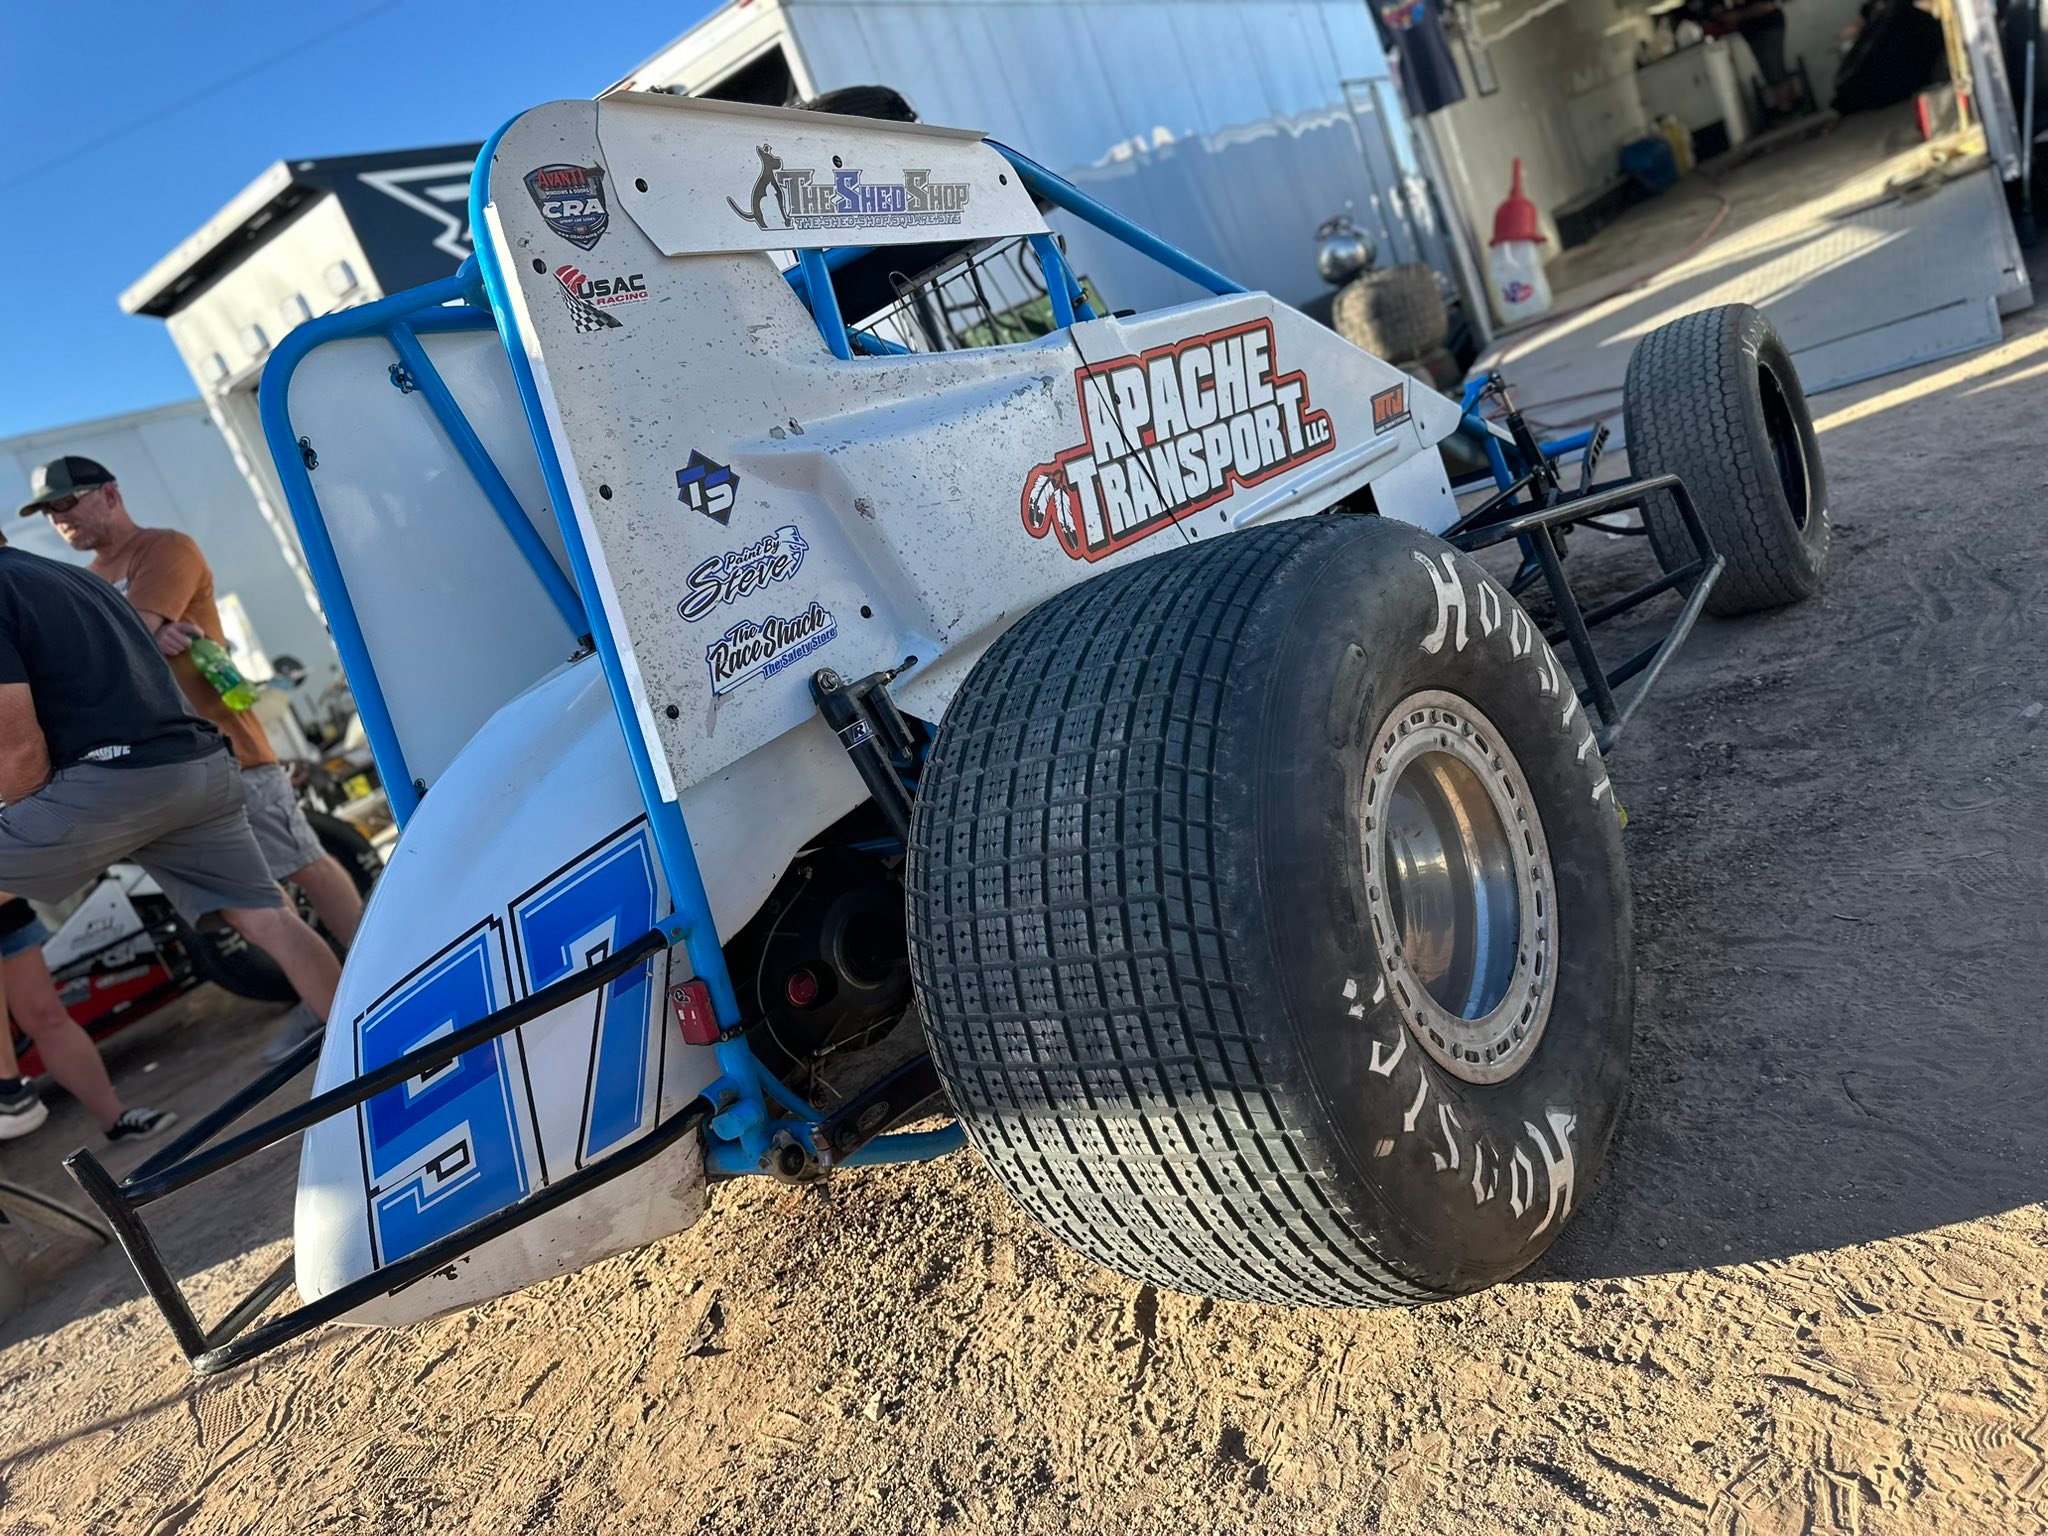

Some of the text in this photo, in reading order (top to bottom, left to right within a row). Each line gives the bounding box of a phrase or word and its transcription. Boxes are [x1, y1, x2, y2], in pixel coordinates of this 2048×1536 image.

[542, 198, 606, 219] CRA
[577, 273, 646, 300] USAC
[597, 291, 648, 305] RACING
[1081, 327, 1272, 462] APACHE
[1063, 382, 1330, 545] TRANSPORT LLC
[727, 538, 780, 571] Paint By
[679, 553, 791, 618] Steve
[729, 623, 758, 647] The
